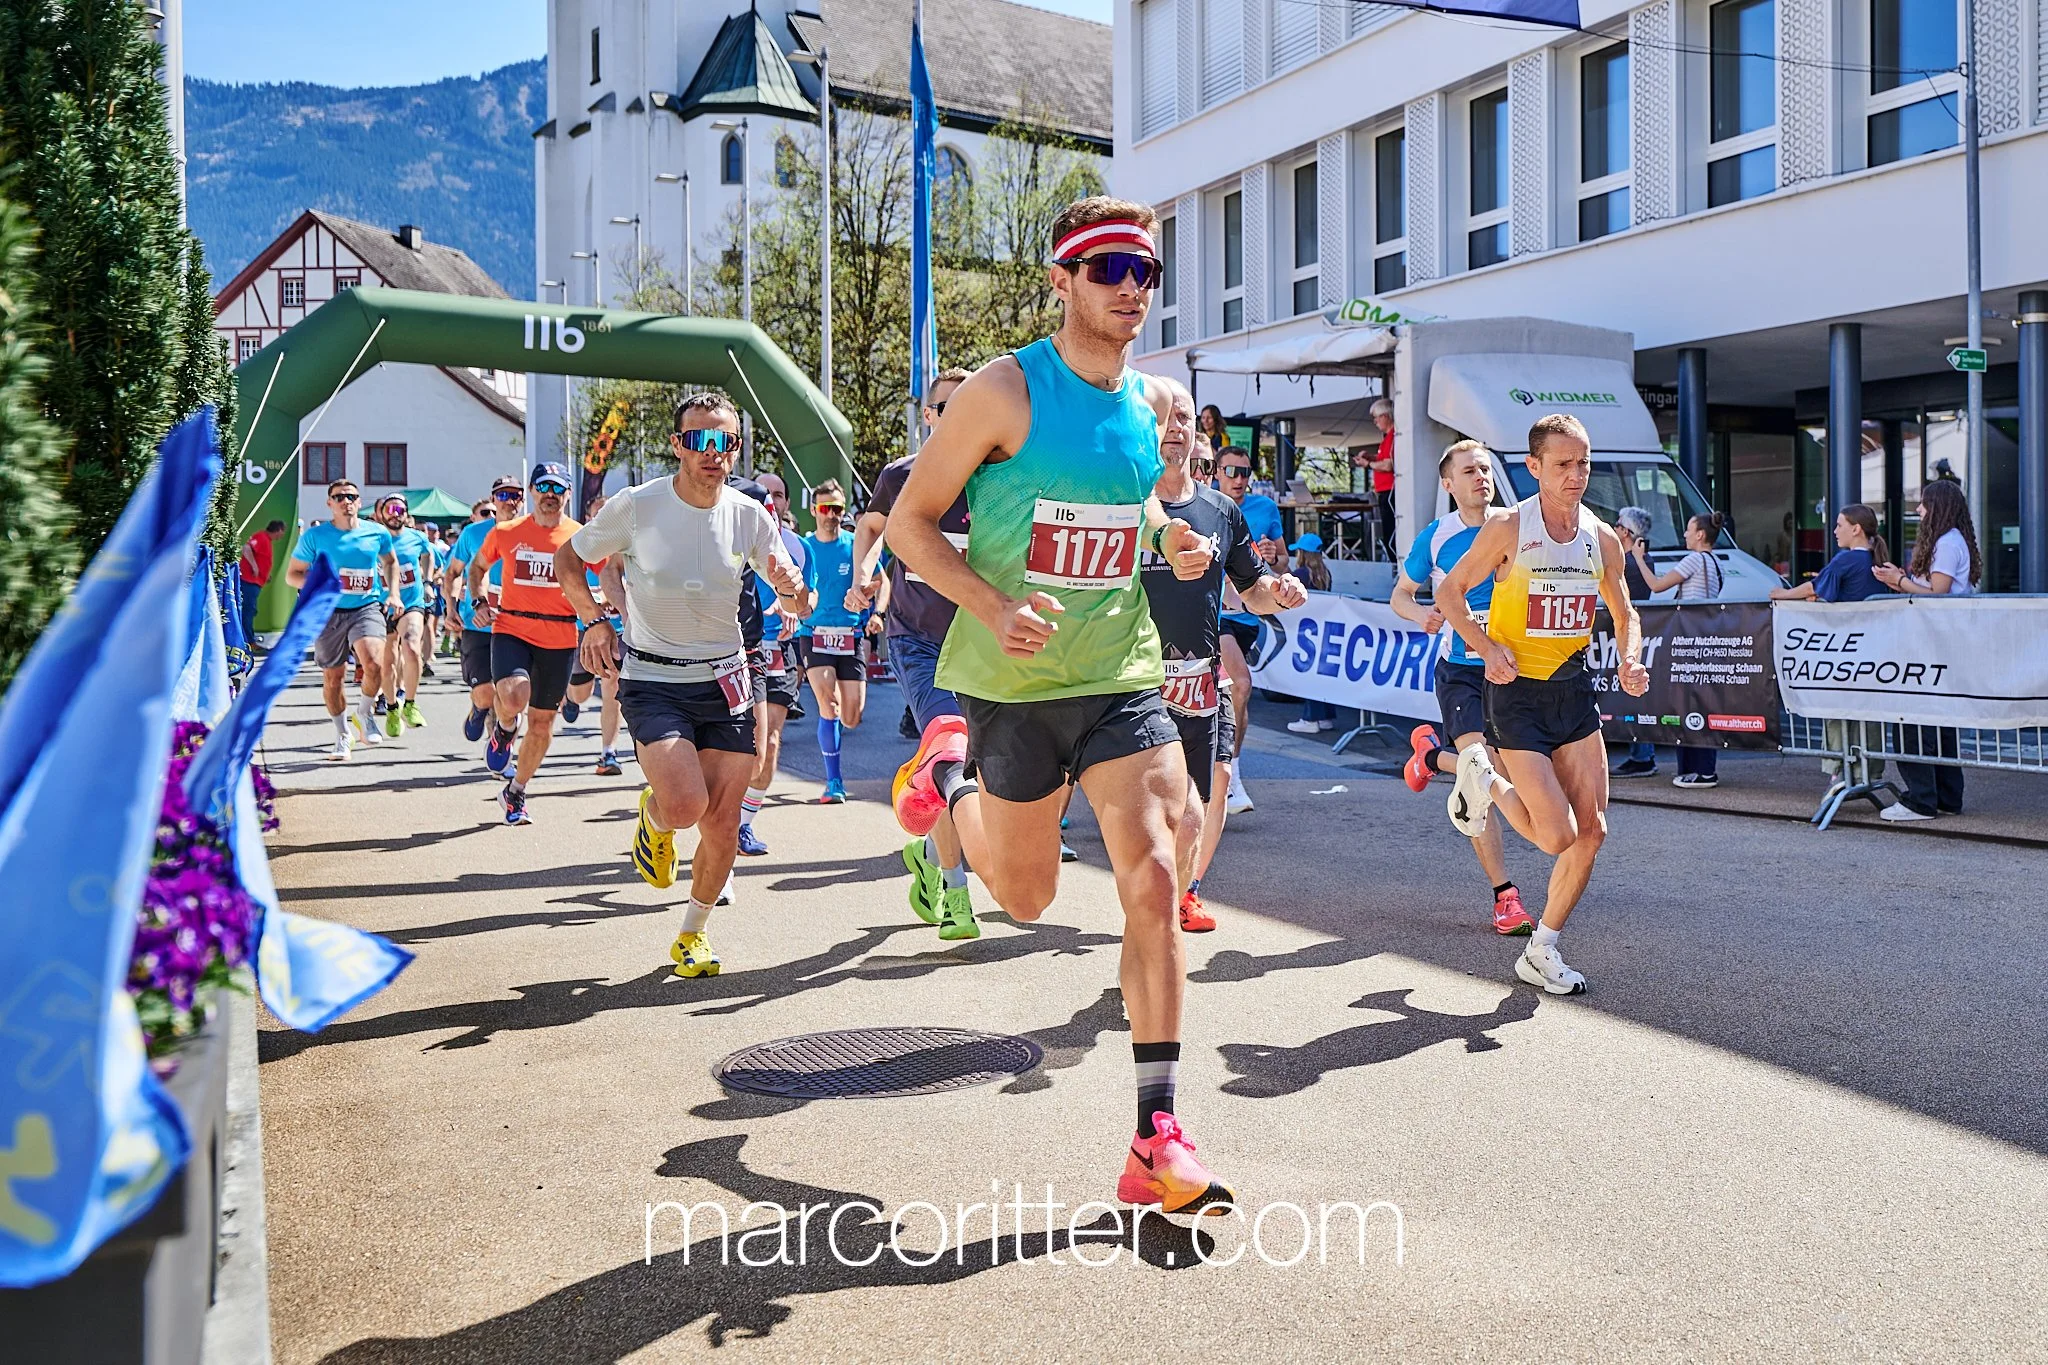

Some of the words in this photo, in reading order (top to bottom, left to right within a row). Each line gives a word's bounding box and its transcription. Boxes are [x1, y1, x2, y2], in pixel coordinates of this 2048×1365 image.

[582, 320, 612, 333] 1861
[1532, 391, 1619, 404] WIDMER
[235, 459, 267, 485] lb
[1052, 528, 1126, 577] 1172
[528, 561, 554, 578] 1071
[1531, 565, 1594, 576] www.run2gether.com
[1540, 596, 1589, 629] 1154
[822, 635, 845, 647] 1072
[1672, 636, 1694, 646] Altherr
[1694, 636, 1741, 648] Nutzfahrzeuge
[1741, 636, 1753, 646] AG
[1784, 628, 1864, 653] SELE
[1292, 617, 1444, 693] SECURI
[1671, 648, 1699, 659] Untersteig
[1728, 648, 1753, 657] Nesslau
[1671, 662, 1734, 675] Zweigniederlassung
[1735, 663, 1763, 674] Schaan
[1781, 656, 1948, 687] RADSPORT
[1726, 675, 1749, 685] Schaan
[1710, 718, 1763, 729] www.altherr.ch
